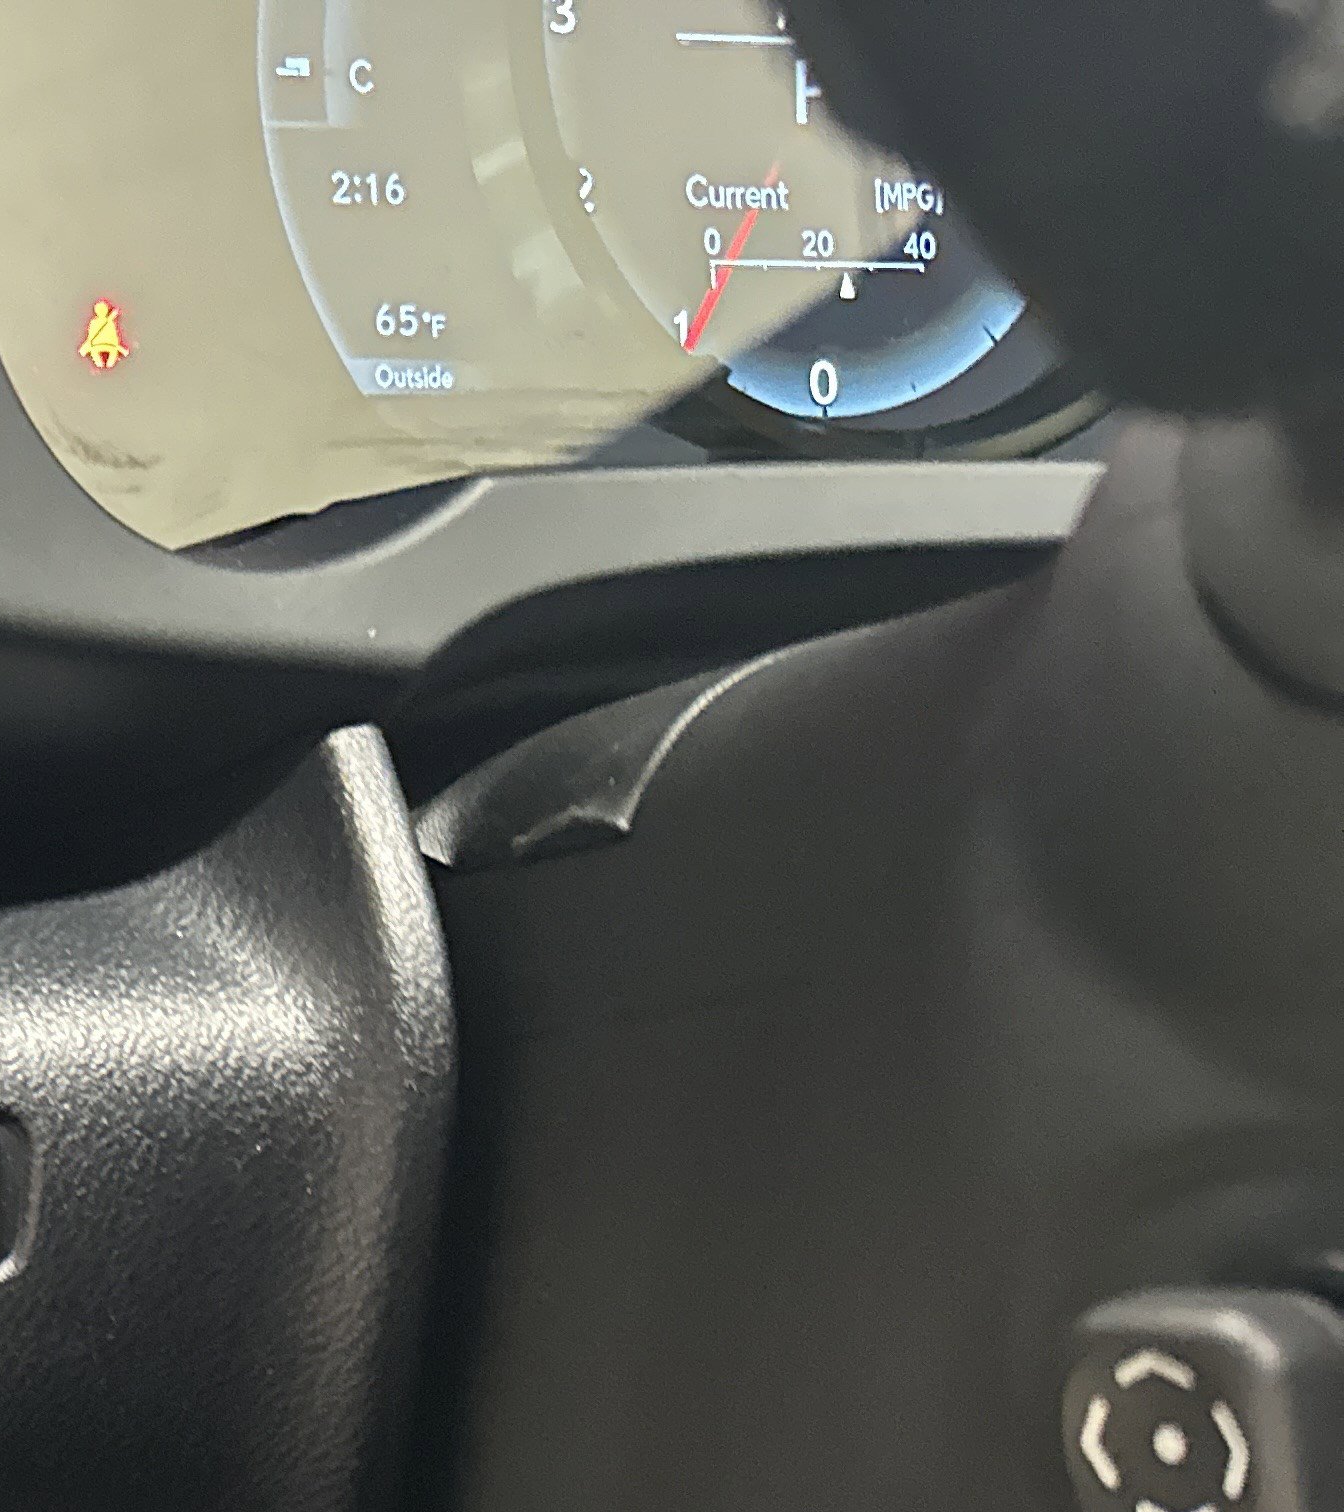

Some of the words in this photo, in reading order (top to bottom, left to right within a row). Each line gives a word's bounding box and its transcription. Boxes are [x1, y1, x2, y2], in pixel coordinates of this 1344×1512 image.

[550, 0, 576, 34] 3
[348, 58, 375, 94] C
[331, 169, 406, 206] 2:16
[685, 173, 790, 211] Current
[703, 226, 722, 256] 0
[800, 229, 835, 257] 20
[902, 231, 937, 260] 40
[673, 308, 688, 348] 1
[374, 362, 455, 389] Outside
[809, 359, 838, 406] 0
